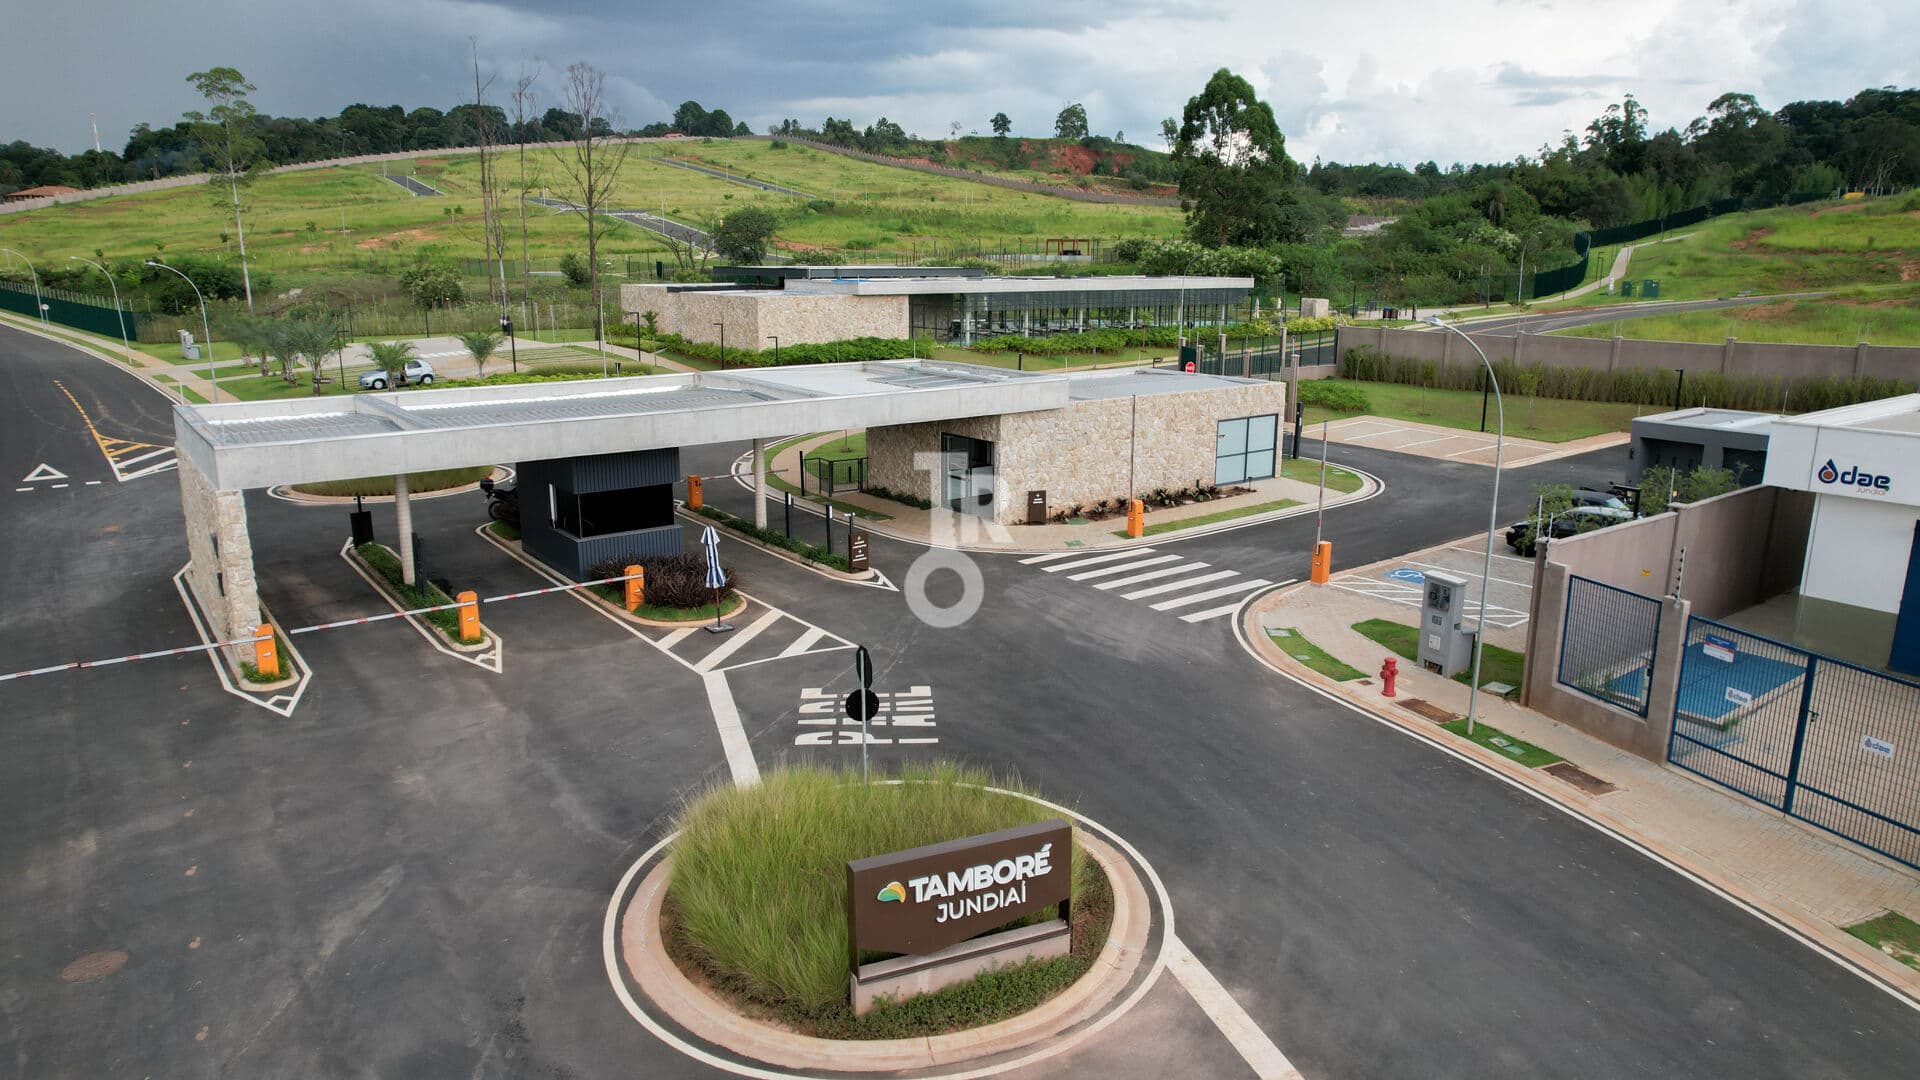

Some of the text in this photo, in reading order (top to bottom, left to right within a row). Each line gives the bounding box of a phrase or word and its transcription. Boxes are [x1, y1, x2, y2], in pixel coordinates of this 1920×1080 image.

[1840, 465, 1891, 492] dae
[908, 842, 1053, 904] TAMBORÉ
[936, 880, 1027, 923] JUNDIAÍ
